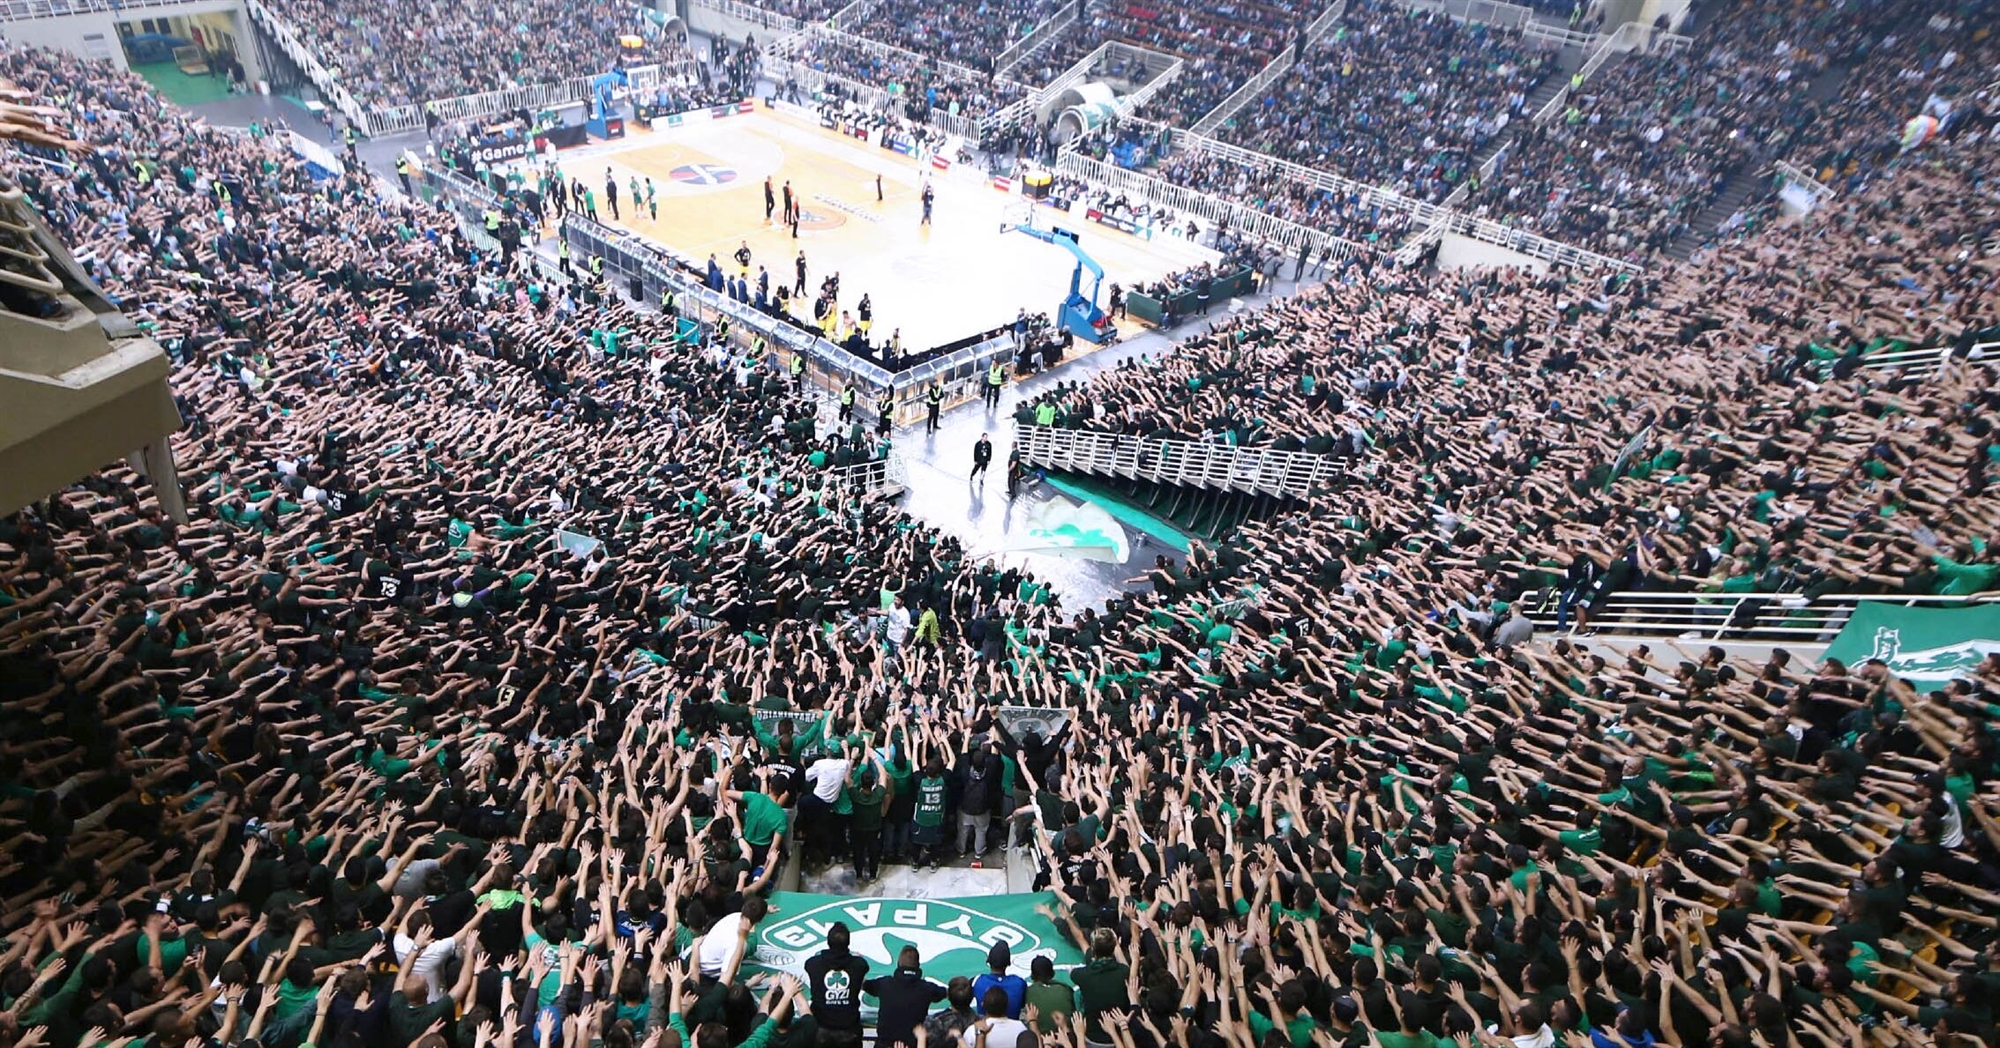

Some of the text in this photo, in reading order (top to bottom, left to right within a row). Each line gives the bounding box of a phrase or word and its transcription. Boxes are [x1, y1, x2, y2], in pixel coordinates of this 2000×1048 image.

[380, 582, 397, 598] 13
[497, 687, 515, 706] 13
[924, 793, 940, 804] 13
